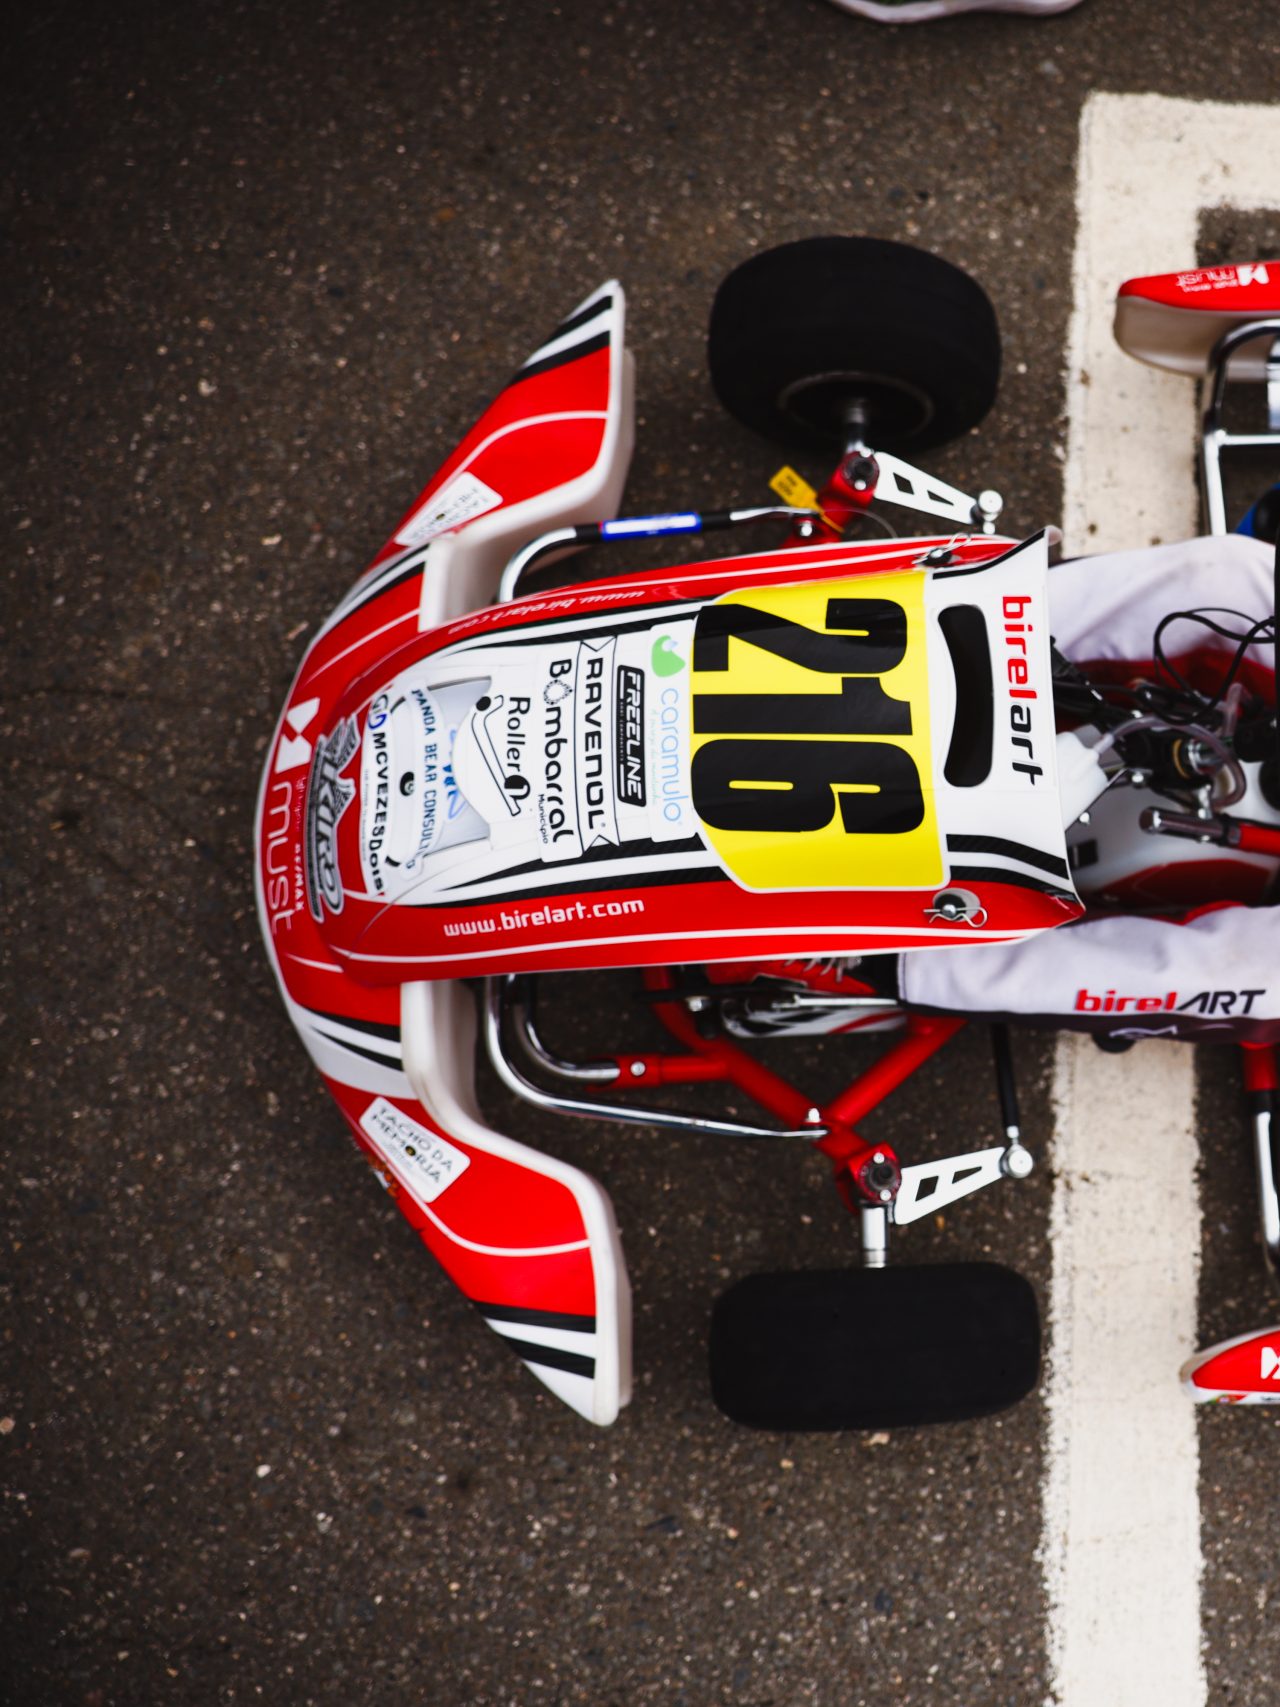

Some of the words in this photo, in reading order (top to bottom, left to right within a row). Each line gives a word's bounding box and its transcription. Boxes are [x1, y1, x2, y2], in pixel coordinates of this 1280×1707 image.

[411, 688, 437, 735] PANDA
[424, 743, 438, 784] BEAR
[505, 696, 530, 772] Roller
[584, 657, 604, 830] RAVENOL
[625, 671, 642, 800] FREELINE
[660, 687, 689, 822] caramulo
[691, 597, 926, 836] 216
[1002, 595, 1043, 786] birelart
[266, 781, 294, 934] must
[443, 899, 645, 938] www.birelart.com
[1073, 988, 1267, 1015] birelART
